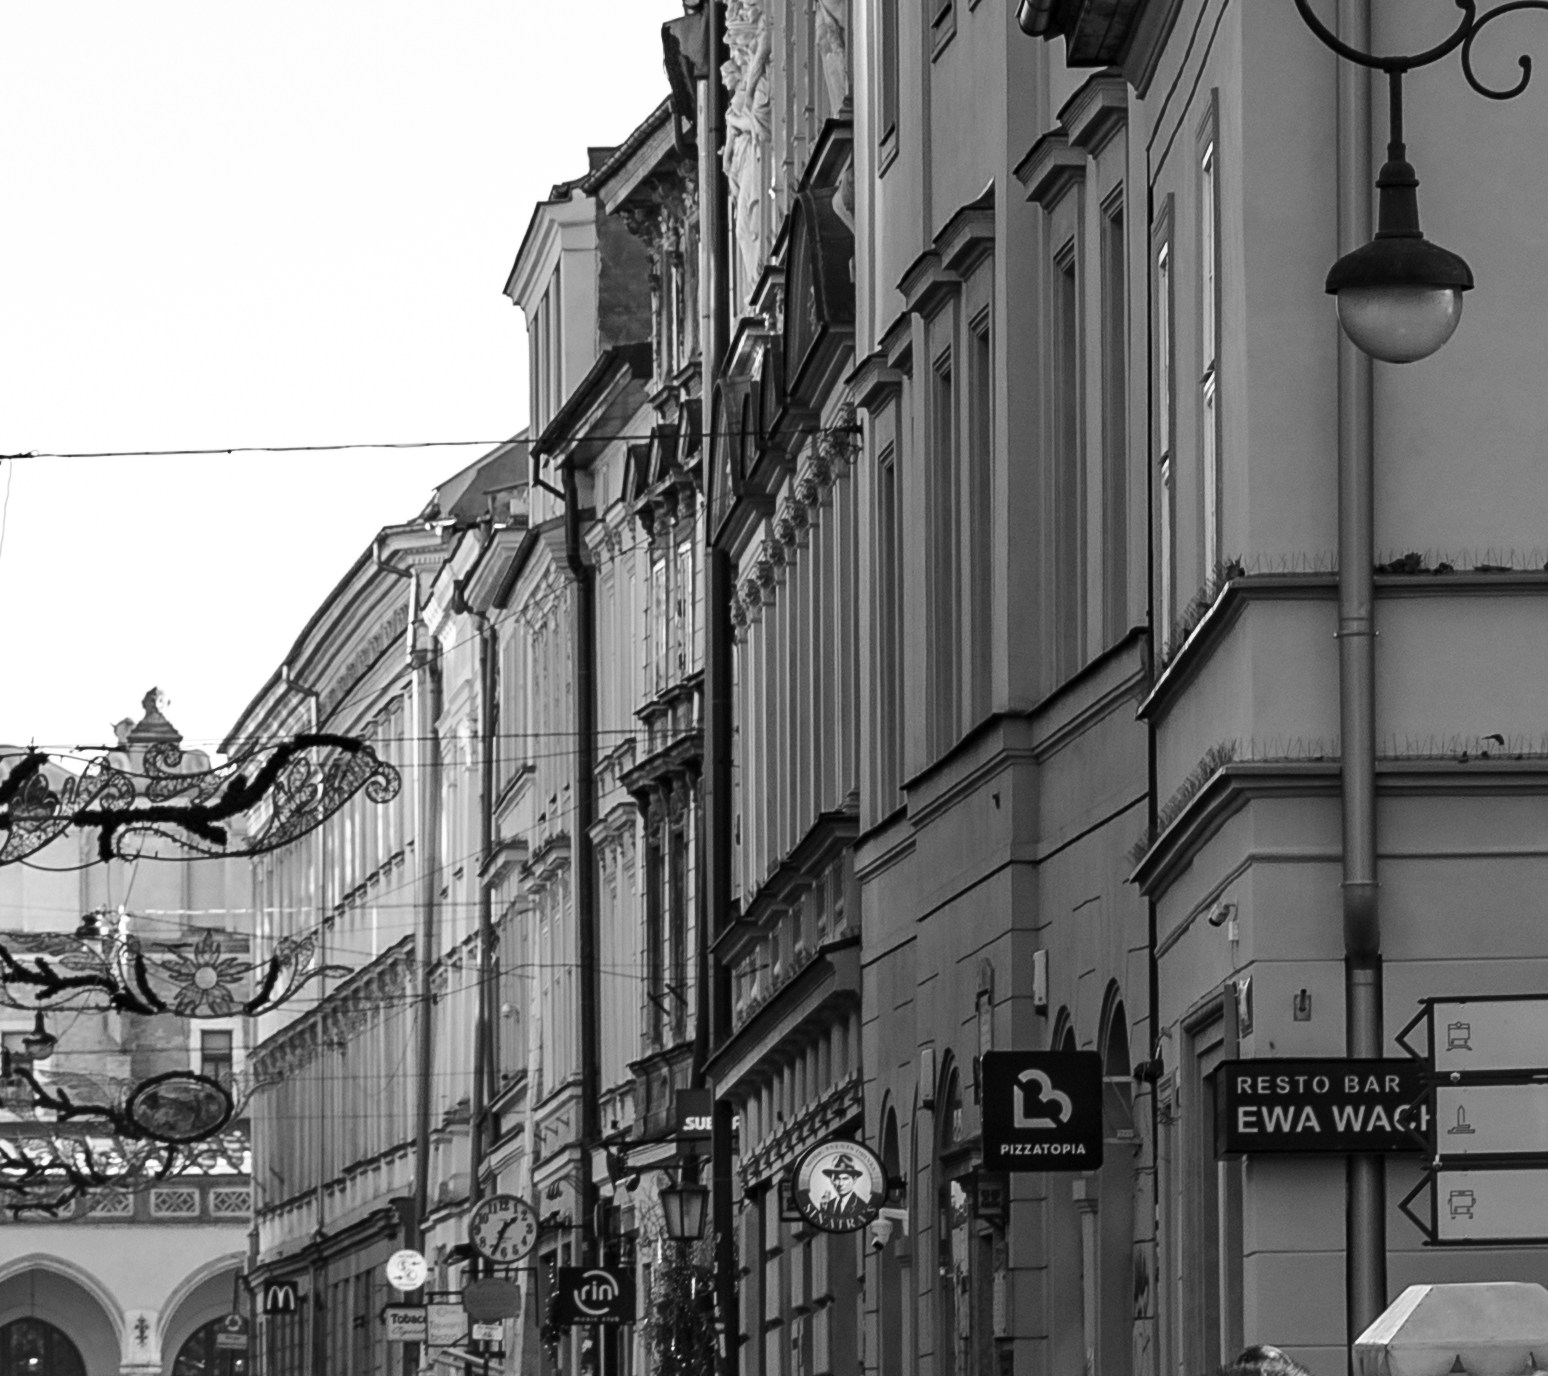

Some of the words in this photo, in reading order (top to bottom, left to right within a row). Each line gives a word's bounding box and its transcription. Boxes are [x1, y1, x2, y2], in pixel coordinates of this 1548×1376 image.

[1237, 1076, 1329, 1094] RESTO
[1345, 1075, 1400, 1093] BAR
[1237, 1105, 1321, 1133] EWA
[1000, 1143, 1086, 1155] PIZZATOPIA
